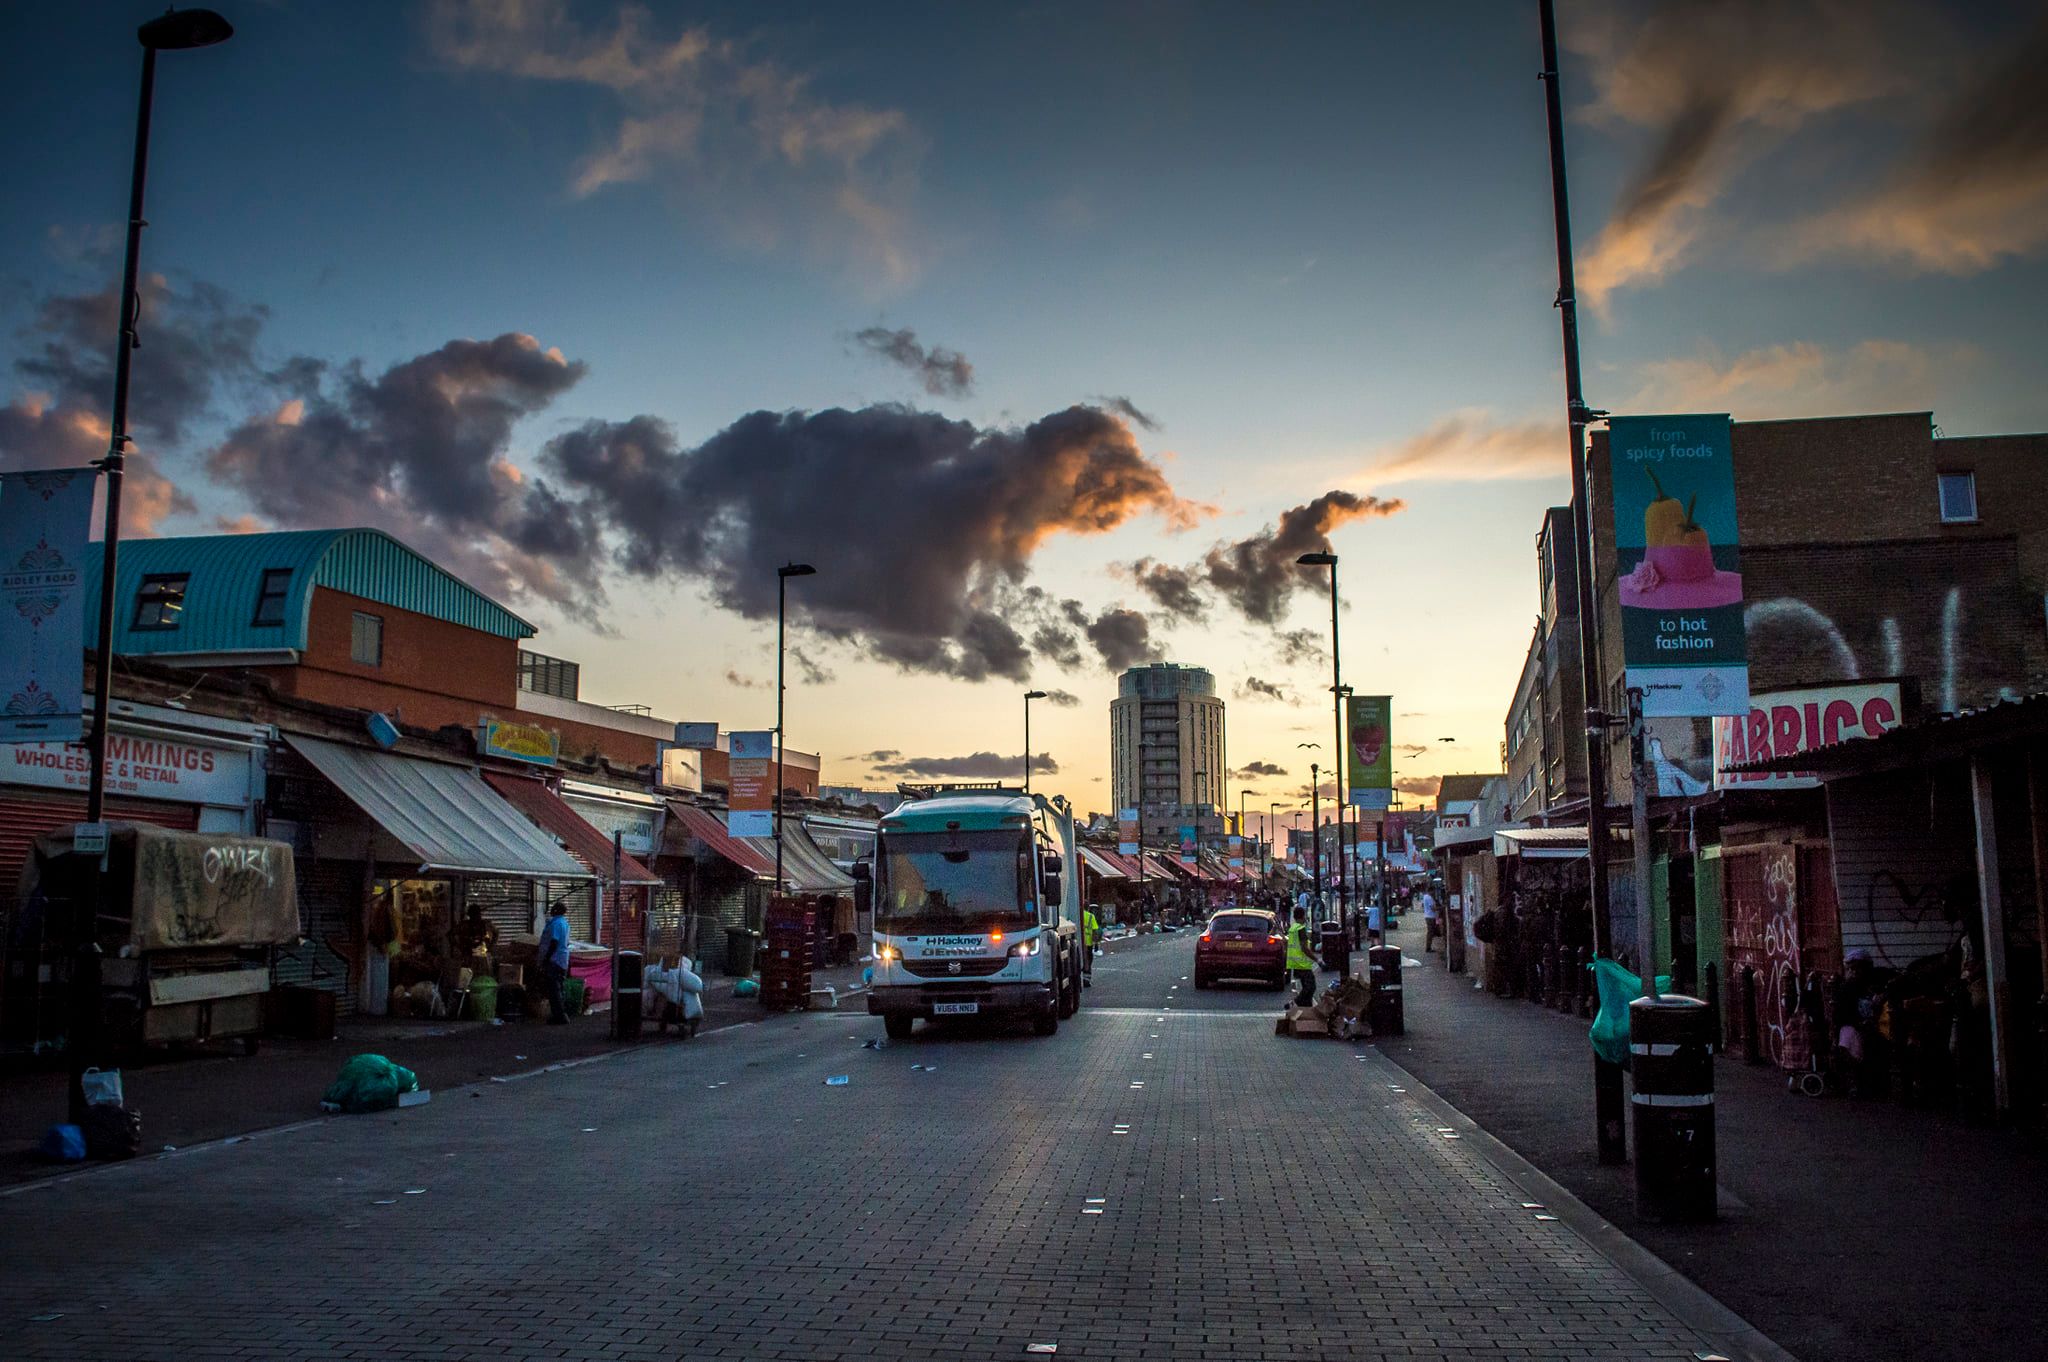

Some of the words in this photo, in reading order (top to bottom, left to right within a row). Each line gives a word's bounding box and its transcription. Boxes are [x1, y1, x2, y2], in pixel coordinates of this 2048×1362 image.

[1650, 428, 1686, 442] from
[1626, 445, 1665, 462] spicy
[1670, 443, 1713, 459] foods
[45, 573, 76, 583] ROAD
[1660, 619, 1675, 632] to
[1680, 617, 1708, 631] hot
[1656, 634, 1714, 650] fashion
[1719, 698, 1895, 785] FABRICS
[64, 735, 215, 774] MMINGS
[15, 749, 114, 776] WHOLESE
[118, 766, 129, 778] &
[133, 765, 179, 784] RETAIL
[938, 937, 983, 945] Hackney
[922, 947, 987, 956] DENNIS
